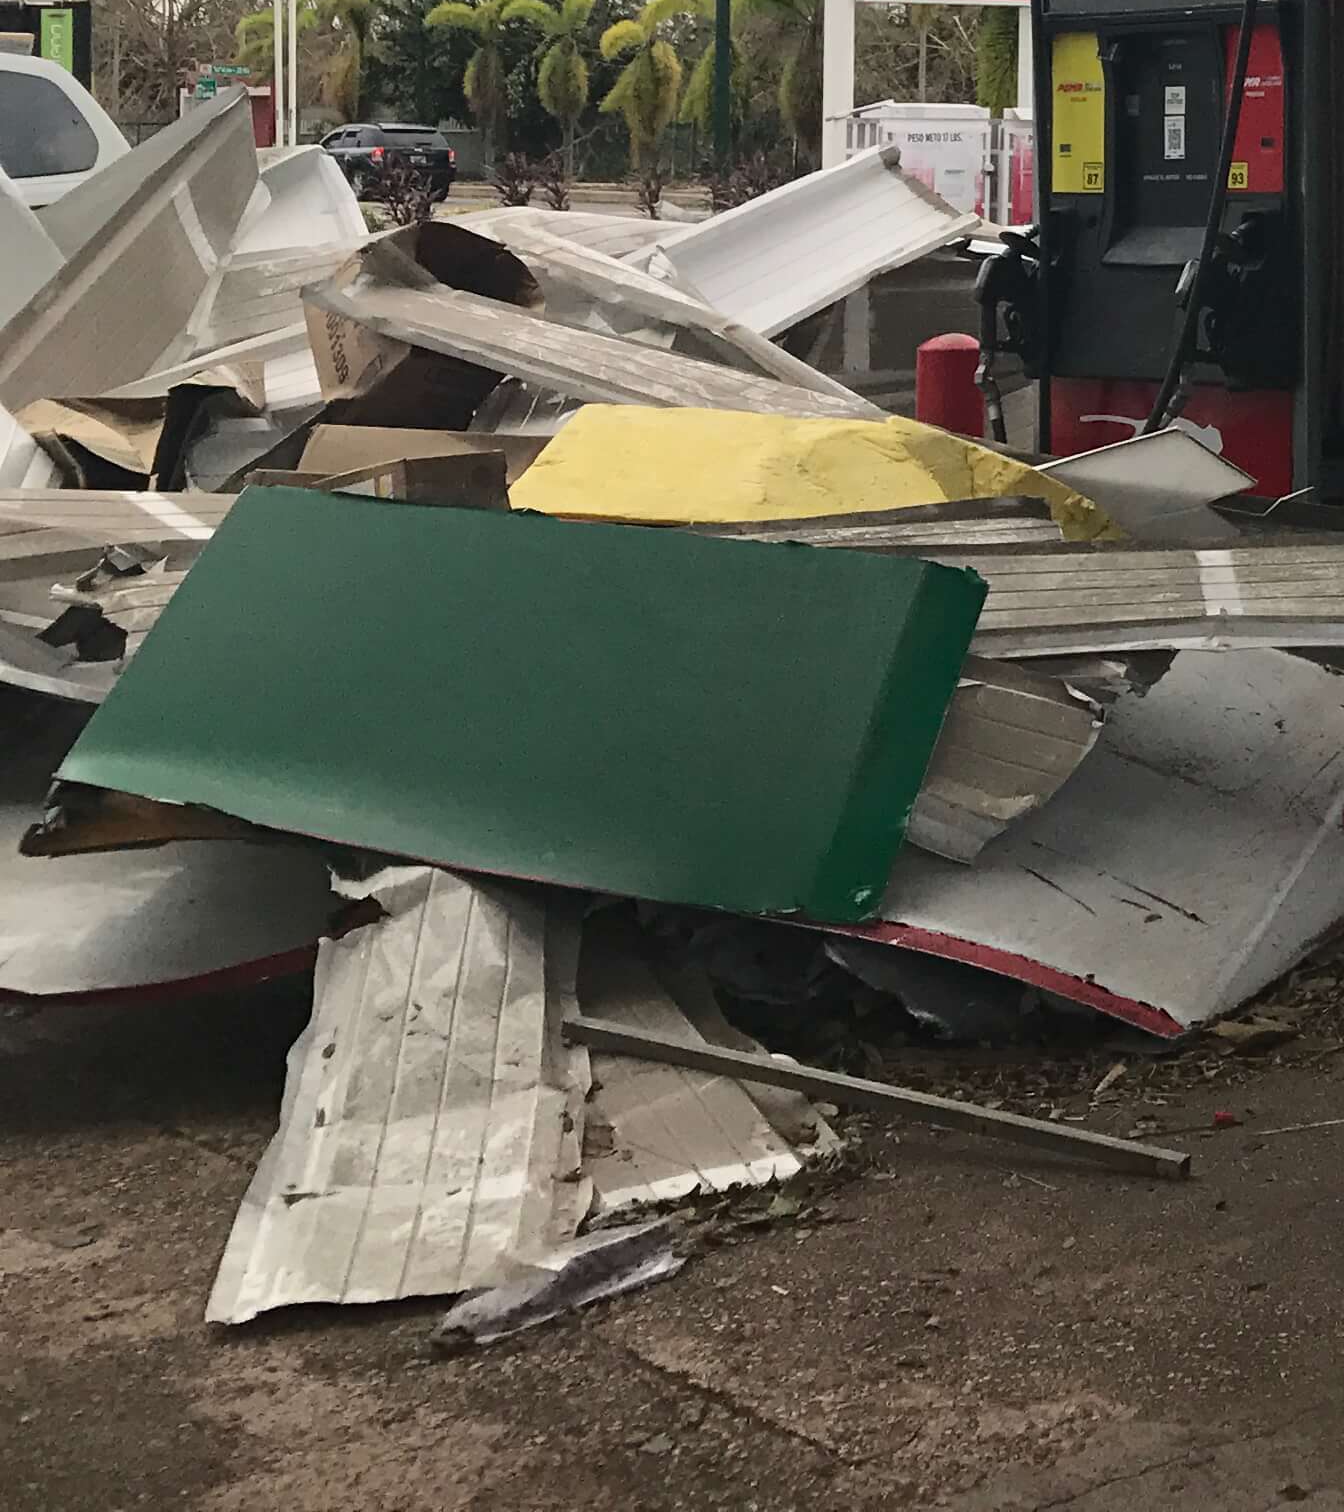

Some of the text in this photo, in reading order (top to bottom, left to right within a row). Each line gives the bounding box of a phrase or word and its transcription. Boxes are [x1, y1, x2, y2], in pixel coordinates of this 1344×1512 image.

[907, 133, 924, 142] PESO
[1087, 173, 1099, 185] 87
[1232, 172, 1244, 185] 93
